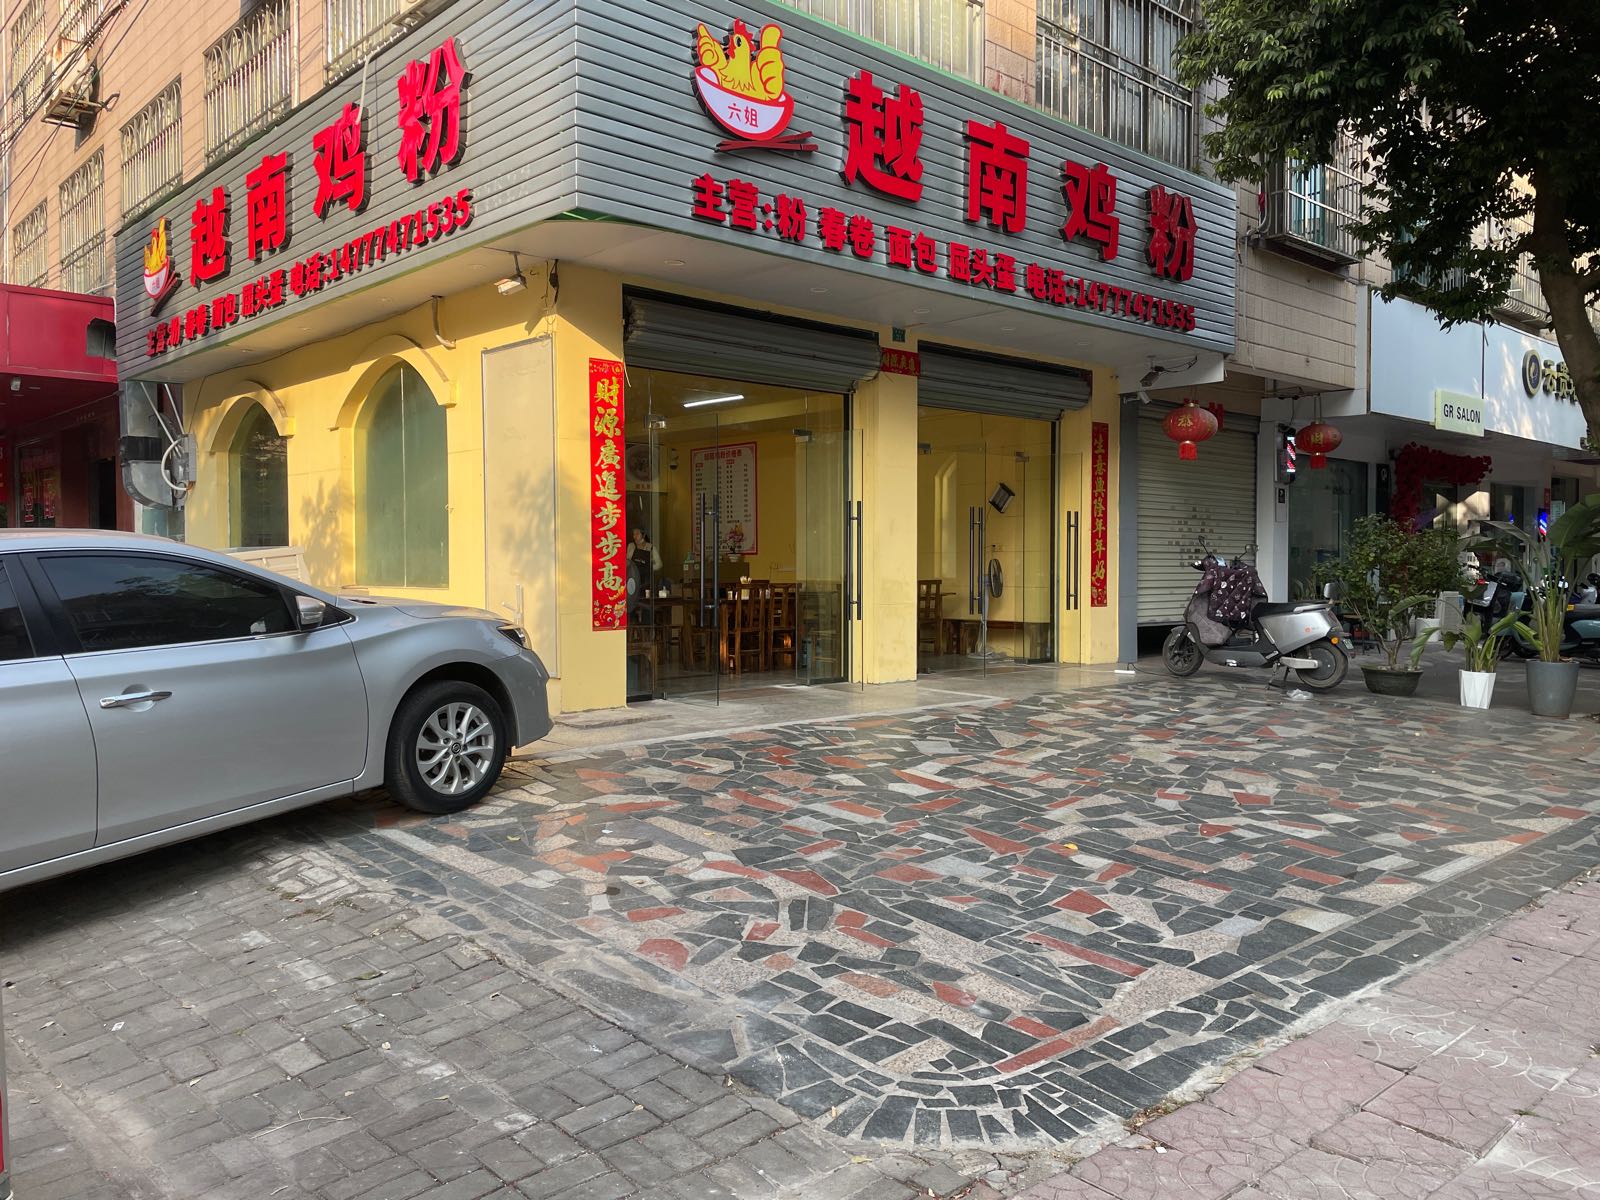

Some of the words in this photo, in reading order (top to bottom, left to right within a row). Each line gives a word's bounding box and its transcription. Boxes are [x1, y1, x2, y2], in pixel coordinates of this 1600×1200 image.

[728, 103, 759, 128] 六姐
[189, 37, 467, 288] 越南鸡粉
[842, 70, 1197, 281] 越南鸡粉
[694, 173, 809, 241] 主营:粉
[818, 207, 876, 258] 春卷
[886, 225, 939, 273] 面包
[949, 241, 1017, 292] 屈头蛋
[211, 293, 238, 329] 面包
[1443, 403, 1454, 419] GR
[1456, 406, 1481, 424] SALON
[1543, 360, 1578, 401] 云贵
[593, 376, 623, 592] 財源廣進步步高
